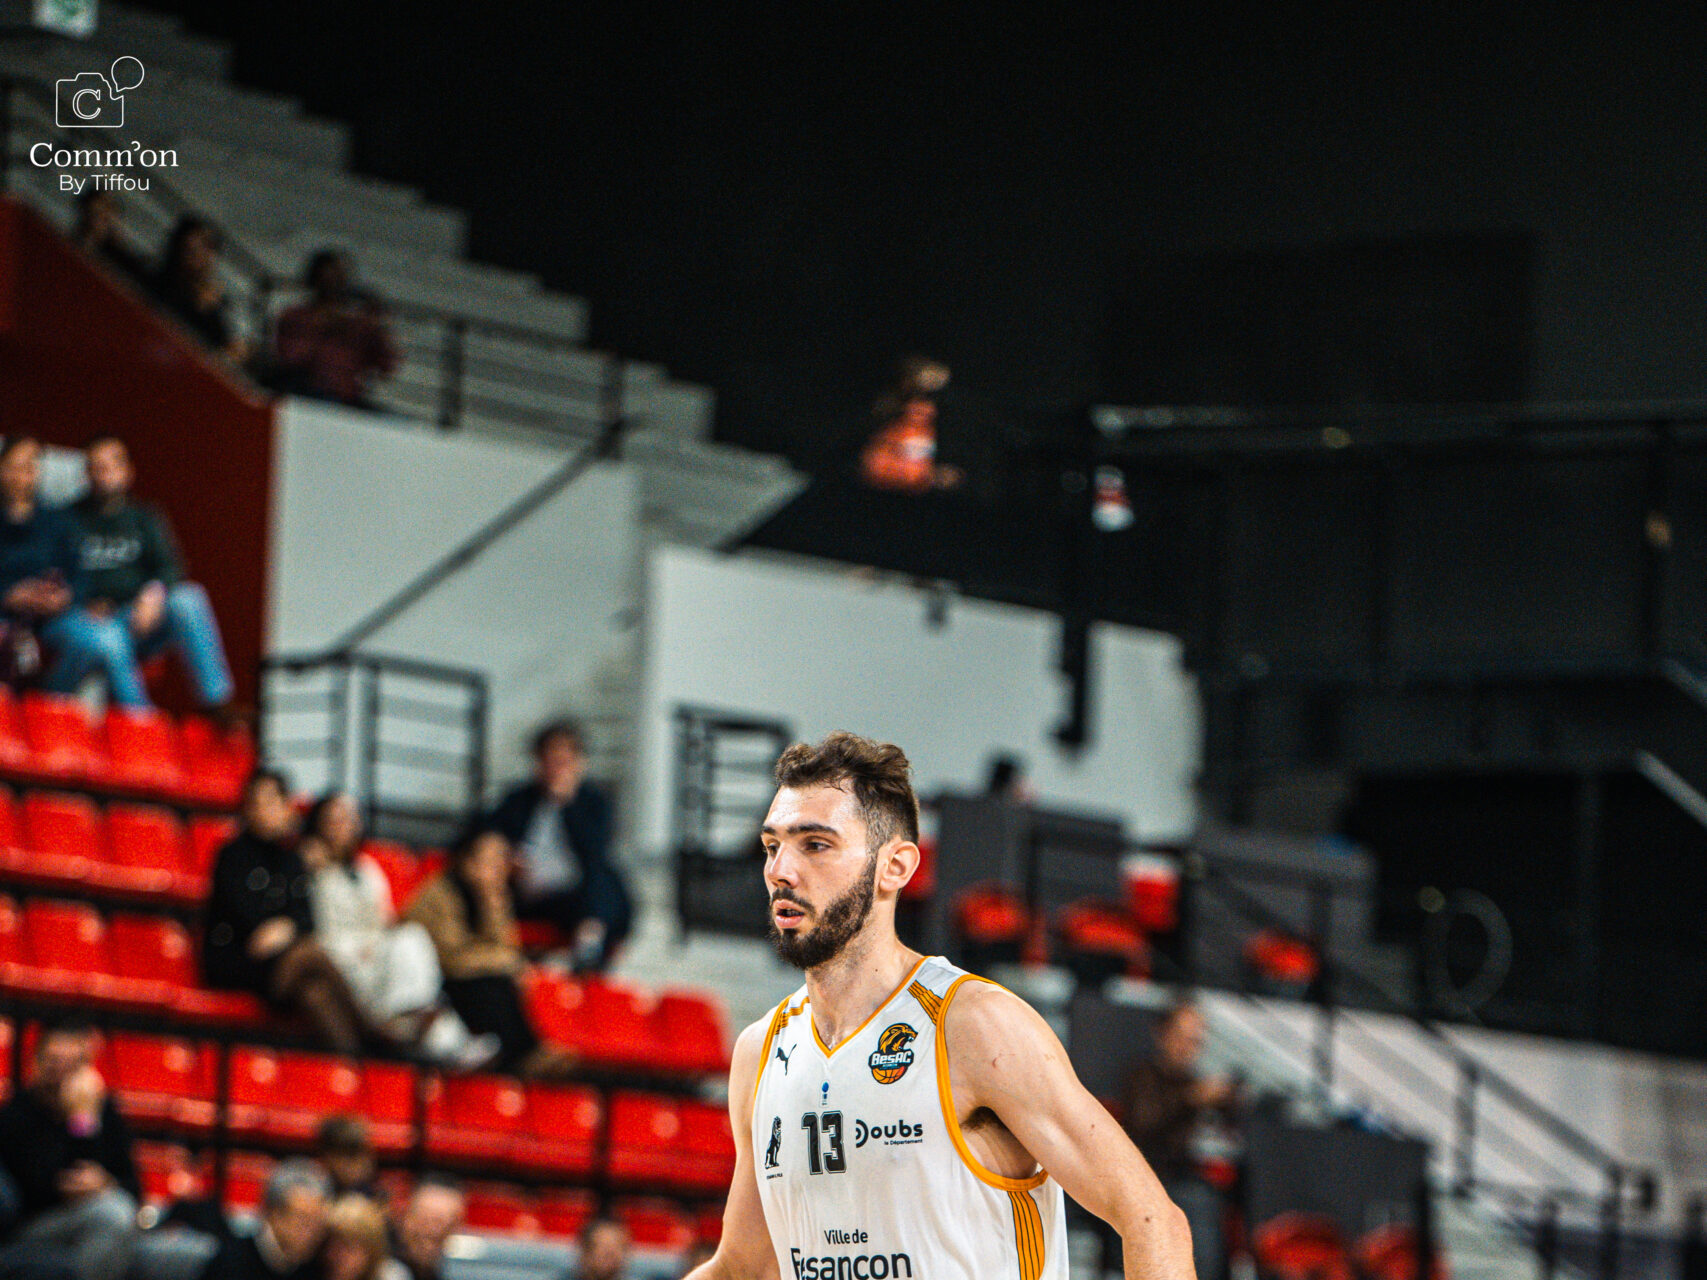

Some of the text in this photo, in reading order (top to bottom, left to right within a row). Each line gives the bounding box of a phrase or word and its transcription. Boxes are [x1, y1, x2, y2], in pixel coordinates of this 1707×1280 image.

[801, 1110, 847, 1175] 13
[856, 1118, 923, 1148] Doubs
[824, 1228, 868, 1245] Ville de
